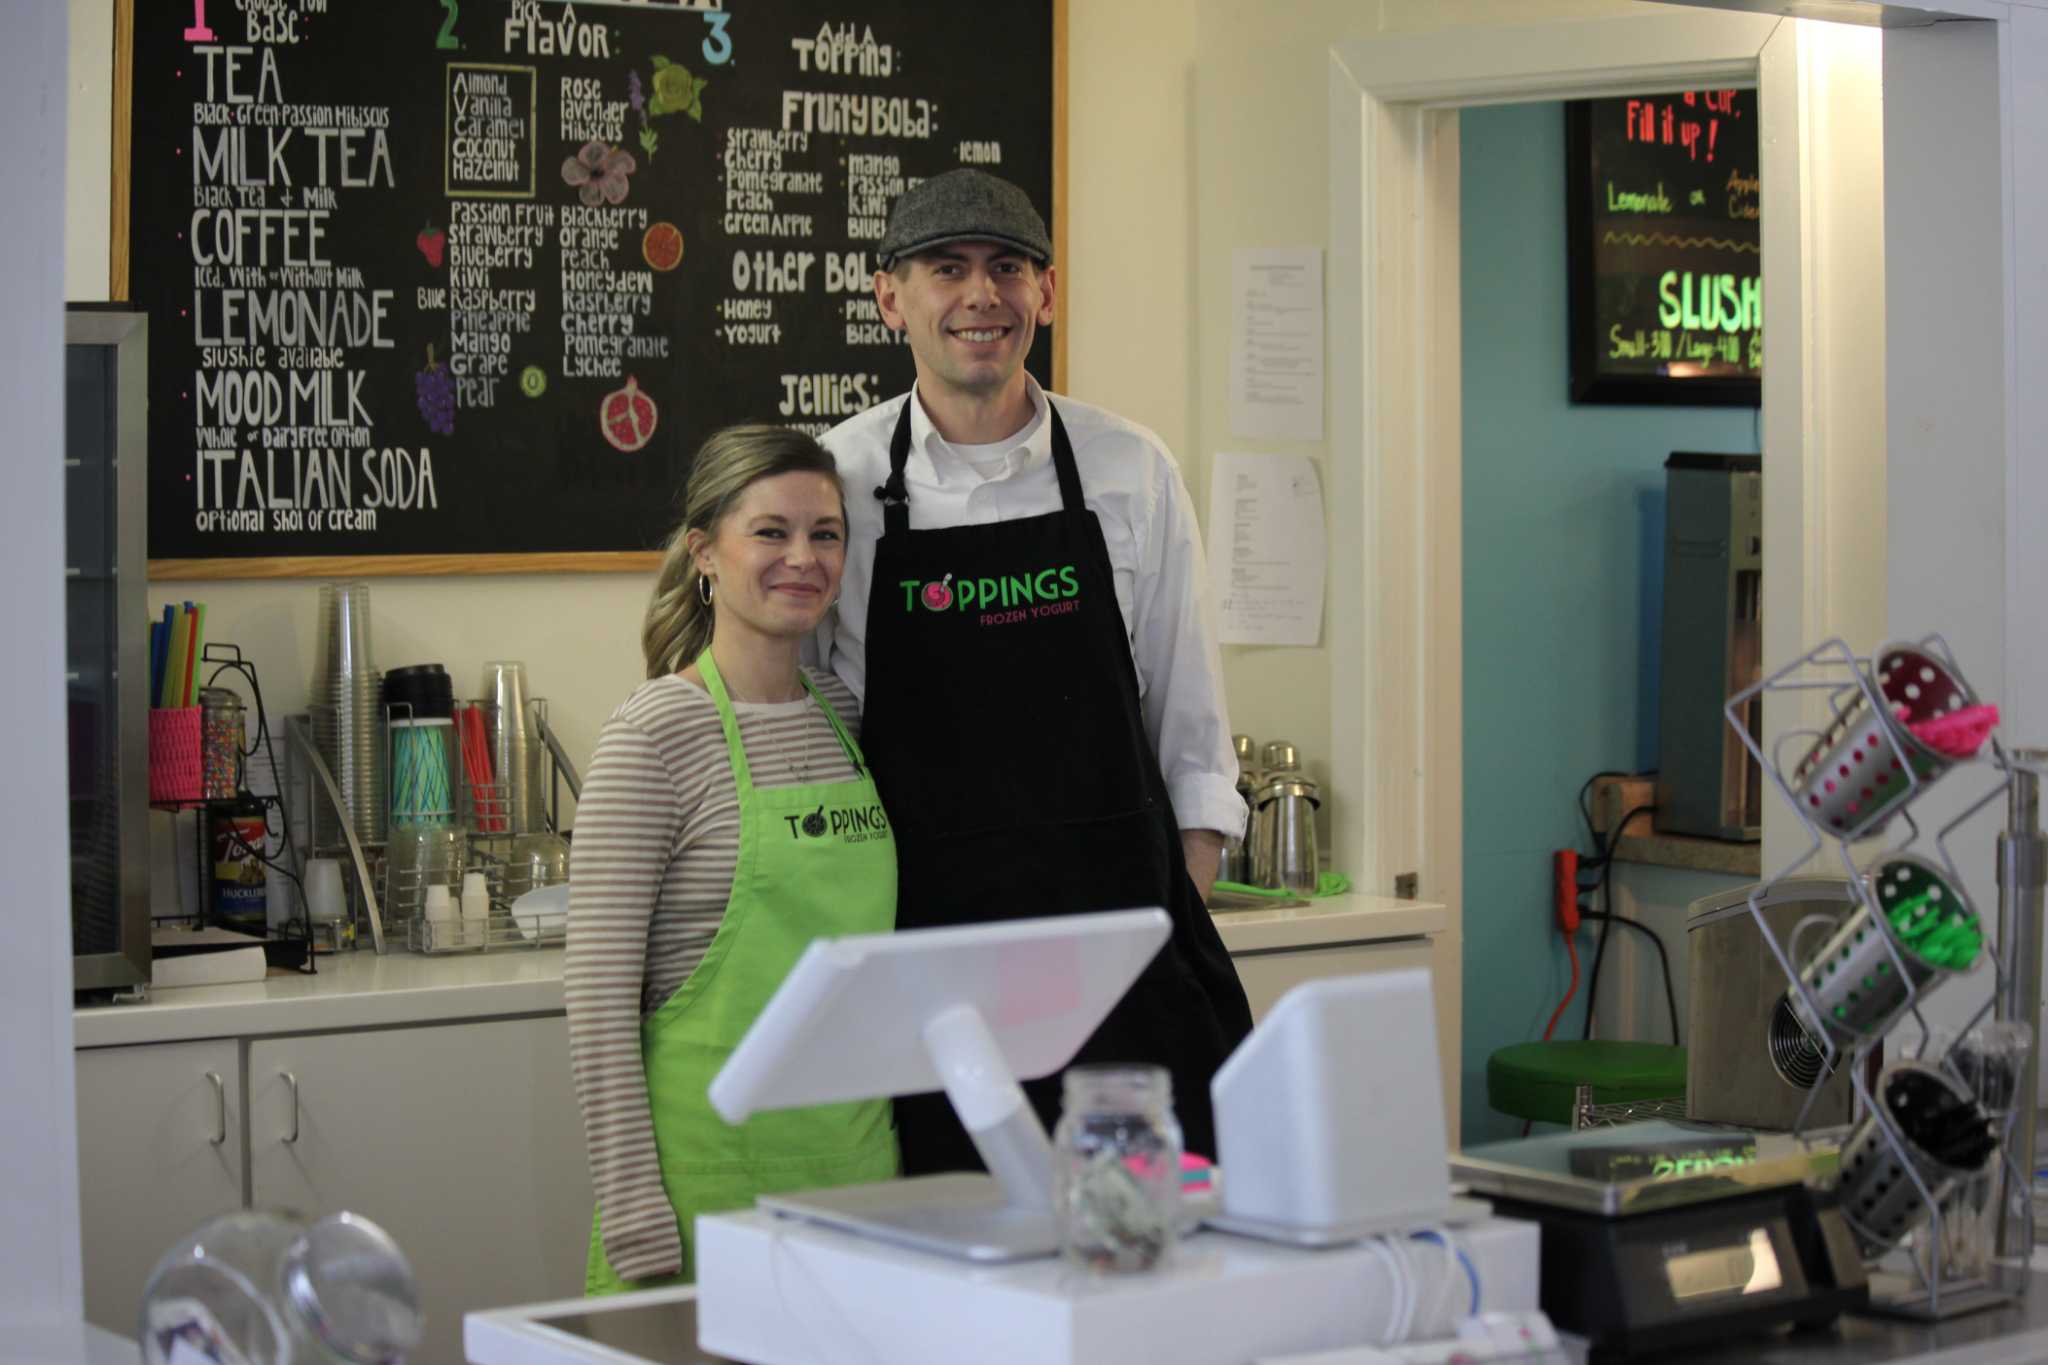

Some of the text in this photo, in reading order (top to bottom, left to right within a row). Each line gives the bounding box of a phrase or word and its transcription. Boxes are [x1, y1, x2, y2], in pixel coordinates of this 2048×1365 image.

[193, 46, 283, 103] TEA
[453, 72, 508, 96] Almond
[561, 77, 602, 99] Rose
[283, 106, 332, 126] Passion
[454, 95, 512, 118] Vanilla
[782, 91, 868, 136] Fruity
[454, 116, 525, 139] Caramel
[561, 121, 623, 142] Hibiscus
[1626, 100, 1656, 143] Fill
[1660, 104, 1675, 145] it
[193, 127, 394, 188] MILK TEA
[453, 138, 516, 160] Coconut
[453, 159, 519, 182] Hazelnut
[727, 170, 823, 194] Pomegranate
[194, 186, 233, 207] Black
[237, 187, 265, 207] Tea
[303, 187, 337, 209] Milk
[848, 176, 904, 197] Passion
[726, 190, 774, 212] Peach
[451, 202, 554, 226] Passion Fruit
[561, 206, 648, 229] Blackberry
[191, 209, 331, 267] COFFEE
[449, 224, 545, 247] Strawberry
[560, 229, 619, 250] Orange
[450, 246, 533, 268] Blueberry
[562, 250, 610, 271] Peach
[280, 267, 333, 288] Without
[336, 267, 366, 288] Milk
[733, 249, 880, 294] Other Bob
[417, 287, 536, 312] Blue Raspberry
[724, 299, 772, 321] Honey
[195, 289, 395, 348] LEMONADE
[561, 313, 634, 334] Cherry
[451, 332, 511, 354] Mango
[725, 323, 782, 345] Yogurt
[846, 323, 891, 345] Black
[564, 335, 669, 358] Pomegranate
[563, 355, 622, 377] Lychee
[196, 370, 373, 427] MOOD MILK
[457, 377, 499, 408] Pear
[196, 447, 438, 510] ITALIAN SODA
[899, 565, 1081, 613] TOPPINGS
[980, 599, 1081, 627] FROZEN YOGURT
[784, 804, 887, 839] TOPPINGS
